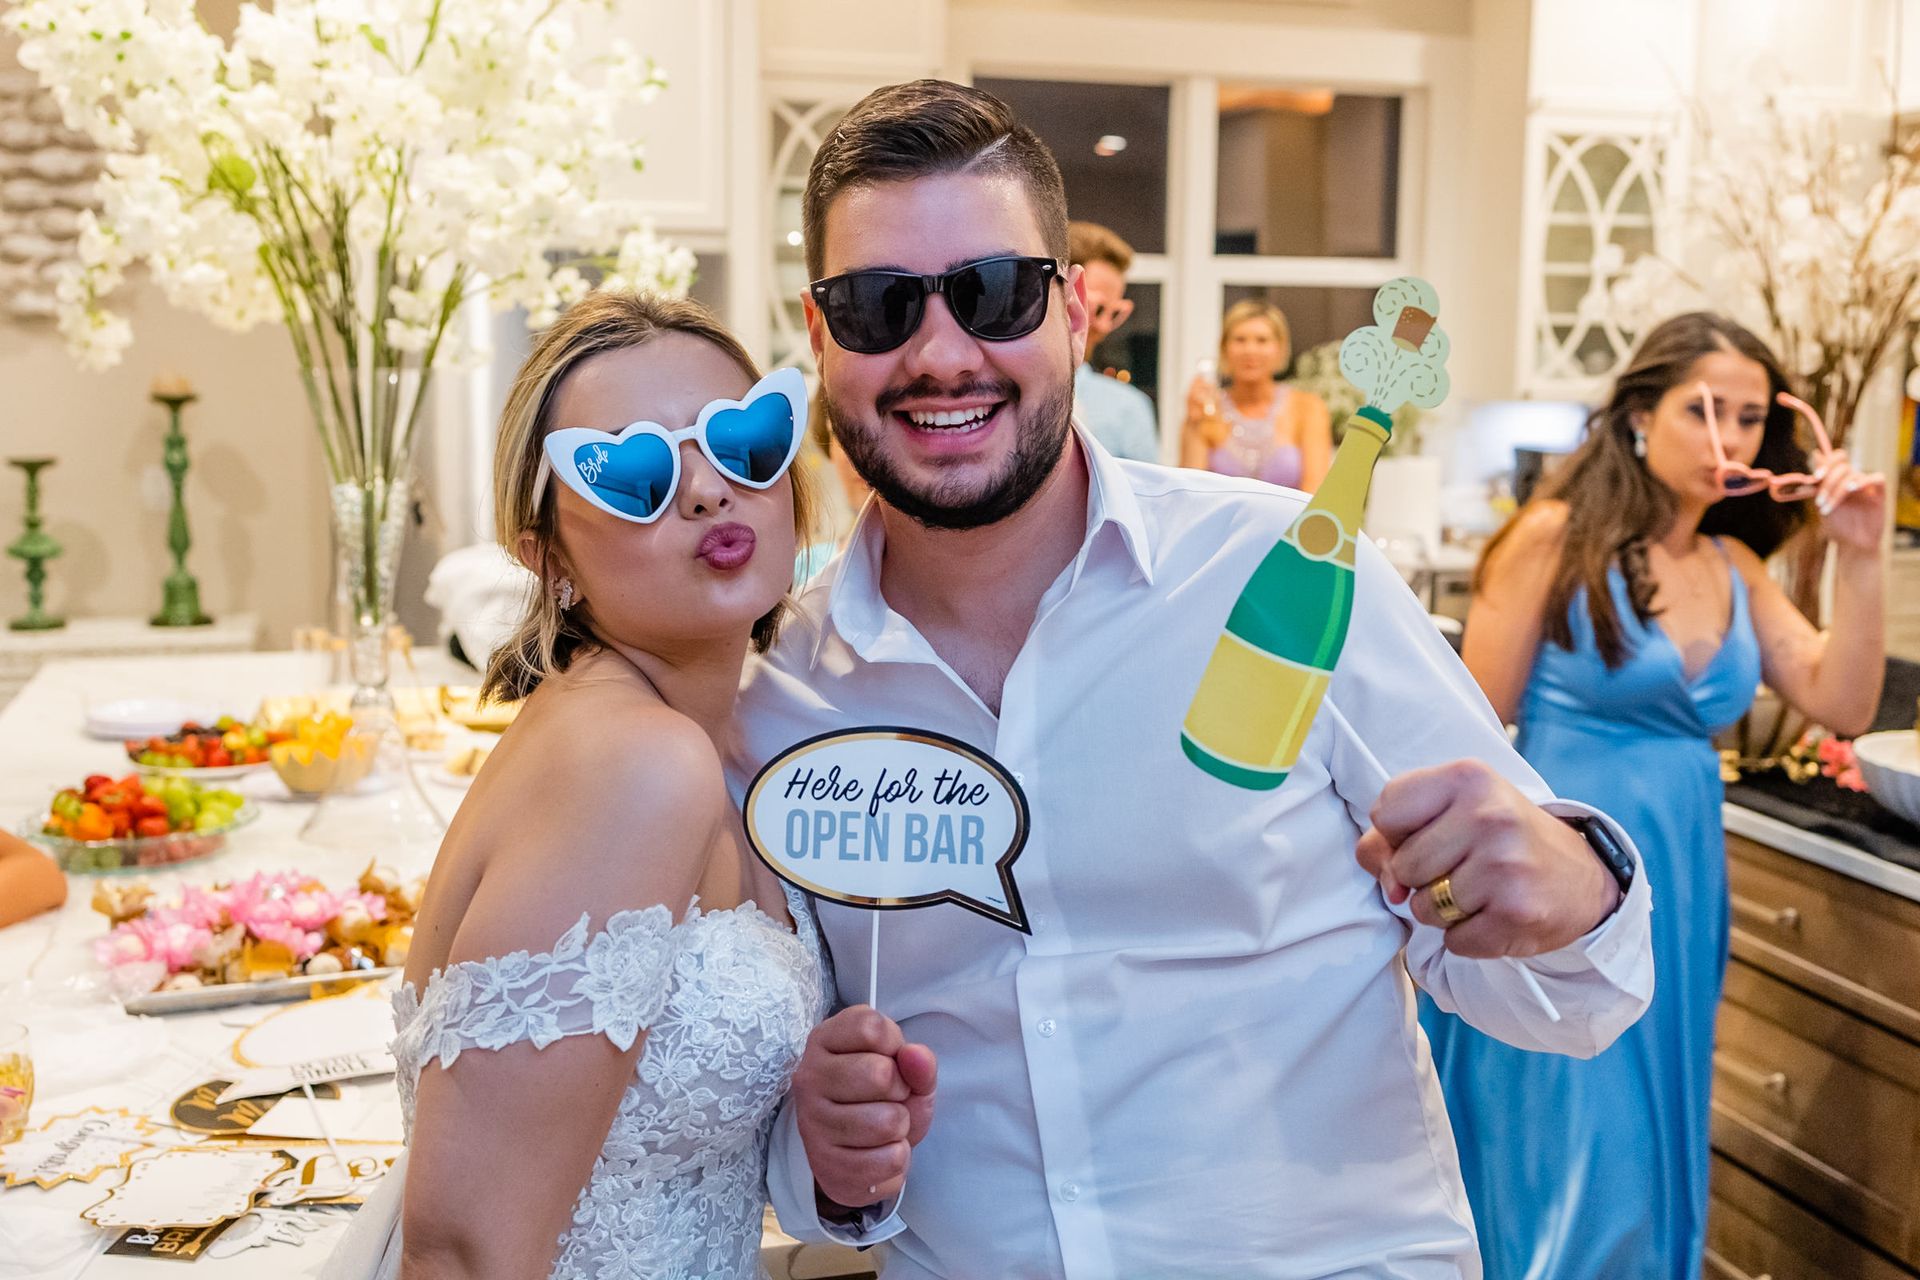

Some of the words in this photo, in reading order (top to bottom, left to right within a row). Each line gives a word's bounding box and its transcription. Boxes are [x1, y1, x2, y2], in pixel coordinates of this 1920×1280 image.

[577, 444, 609, 484] Bride
[784, 765, 863, 802] Here
[868, 768, 923, 818] for
[933, 769, 990, 806] the
[785, 808, 890, 863] OPEN
[903, 812, 985, 866] BAR
